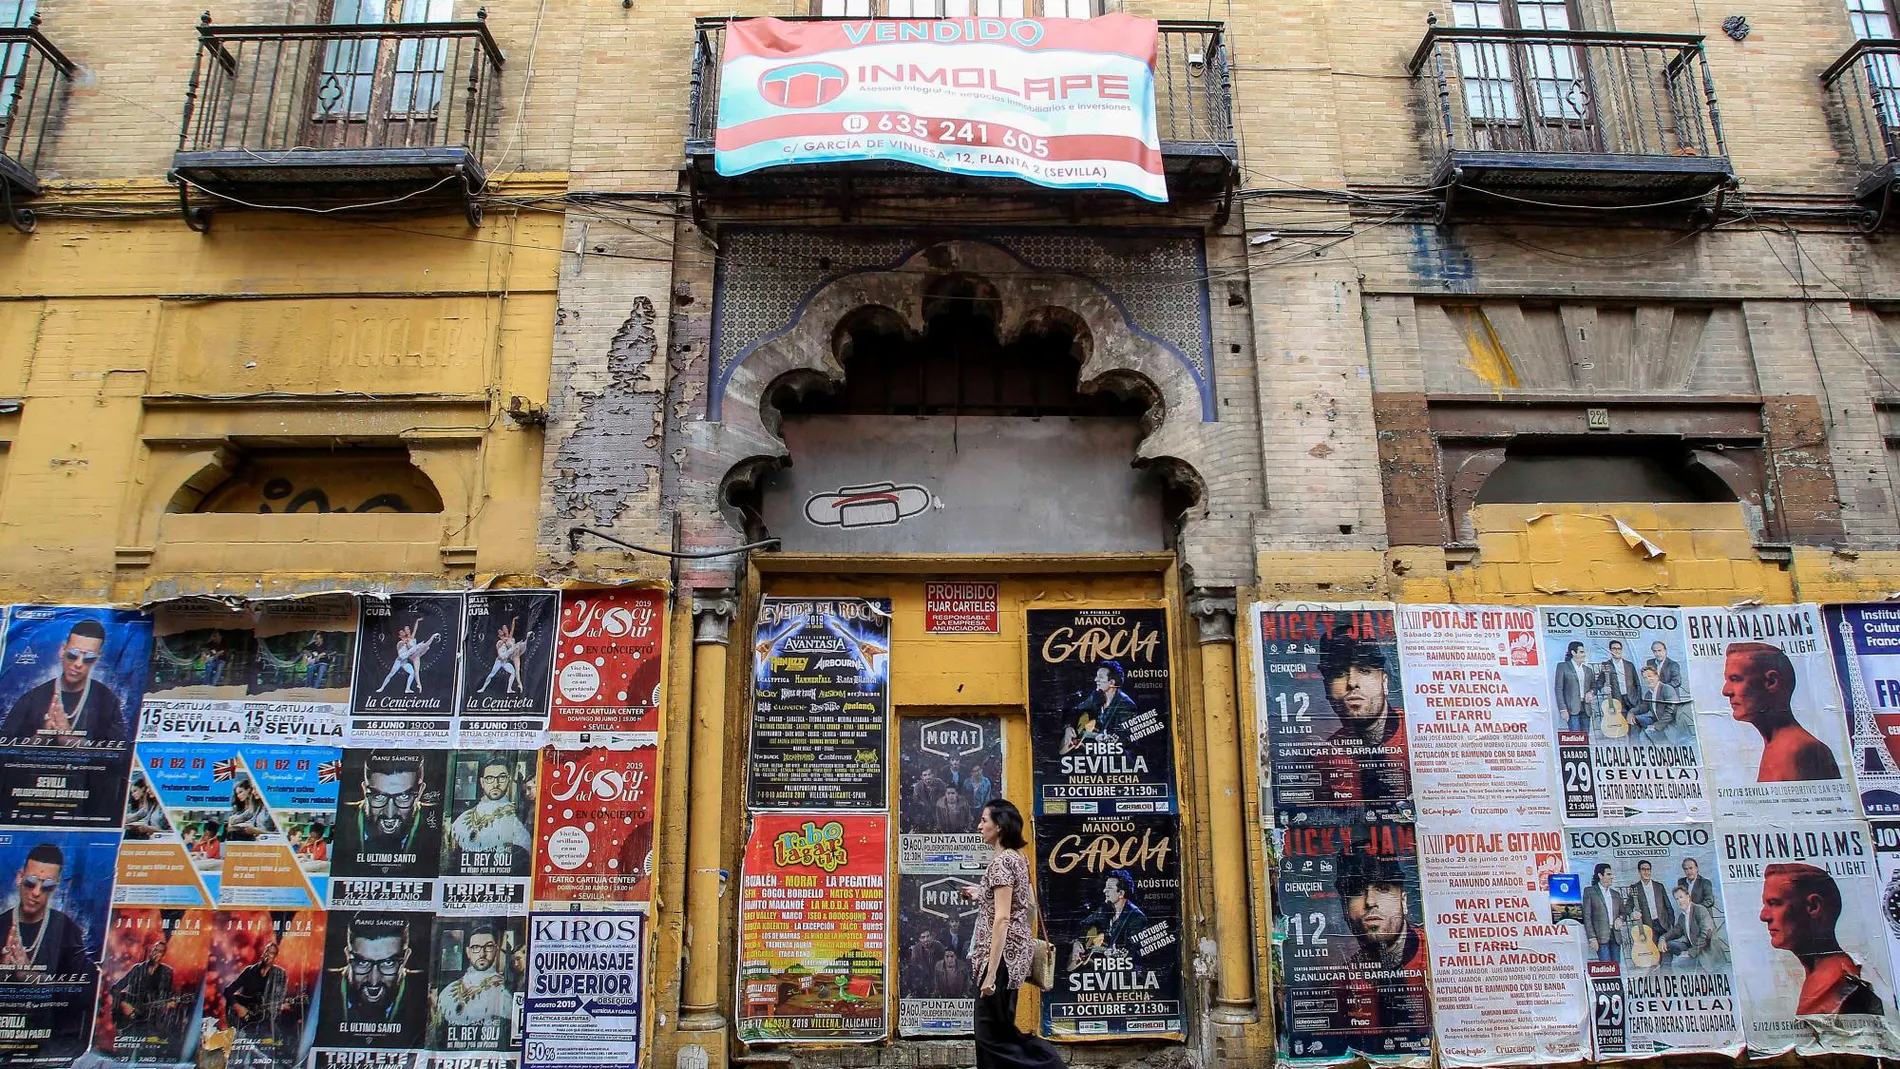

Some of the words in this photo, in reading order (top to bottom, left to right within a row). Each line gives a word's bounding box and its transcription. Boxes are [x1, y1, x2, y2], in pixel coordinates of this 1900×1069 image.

[842, 20, 1044, 46] VENDIDO
[859, 66, 1130, 100] INMOLAPE
[959, 91, 1005, 103] negocios
[1007, 99, 1065, 113] inmobiliarios
[878, 114, 927, 139] 635
[939, 120, 988, 143] 241
[1003, 129, 1049, 157] 605
[803, 137, 862, 152] GARCÍA
[867, 139, 884, 148] DE
[888, 140, 949, 162] VINUESA,
[955, 152, 975, 166] 12,
[980, 154, 1029, 170] PLANTA
[1033, 163, 1041, 175] 2
[1044, 165, 1107, 179] (SEVILLA)
[928, 585, 995, 600] PROHIBIDO
[366, 608, 391, 616] CUBA
[928, 602, 950, 612] FIJAR
[953, 601, 995, 612] CARTELES
[807, 616, 824, 625] 2019
[1075, 616, 1125, 626] MANOLO
[1262, 612, 1340, 640] NICKY
[1351, 610, 1396, 640] JAM
[1422, 612, 1478, 629] POTAJE
[1482, 612, 1534, 629] GITANO
[1546, 613, 1592, 628] ECOS
[1595, 616, 1617, 625] DEL
[1617, 613, 1677, 630] ROCIO
[784, 638, 846, 650] AVANTASIA
[1042, 622, 1160, 663] GARCÍA
[1693, 643, 1723, 656] SHINE
[1780, 640, 1786, 654] A
[1789, 639, 1816, 653] LIGHT
[586, 646, 598, 654] EN
[601, 645, 653, 654] CONCIERTO
[1427, 652, 1465, 660] RAIMUNDO
[1467, 652, 1496, 660] AMADOR
[813, 656, 866, 670] AIRBOURNE
[1127, 669, 1168, 678] ACÚSTICO
[1432, 671, 1465, 680] MARI
[1470, 670, 1501, 680] PEÑA
[1415, 682, 1444, 694] JOSÉ
[1450, 684, 1508, 694] VALENCIA
[365, 697, 377, 708] la
[380, 696, 441, 708] Cenicienta
[1275, 692, 1312, 722] 12
[1426, 697, 1491, 707] REMEDIOS
[1496, 697, 1539, 706] AMAYA
[142, 709, 162, 725] 15
[1451, 710, 1492, 720] FARRU
[163, 721, 240, 733] SEVILLA
[1129, 721, 1165, 742] AGOTADAS
[1279, 726, 1312, 734] JULIO
[927, 730, 977, 745] MORAT
[65, 740, 125, 748] YANKEE
[1085, 742, 1123, 755] FIBES
[1279, 748, 1329, 757] SANLUCAR
[1346, 746, 1403, 756] BARRAMEDA
[1595, 747, 1631, 767] ALCALA
[1635, 747, 1646, 765] DE
[1649, 746, 1697, 767] GUADAIRA
[151, 758, 163, 768] B1
[170, 758, 184, 768] B2
[192, 758, 205, 769] C1
[1061, 756, 1148, 774] SEVILLA
[1069, 775, 1104, 784] NUEVA
[1107, 775, 1139, 784] FECHA
[1564, 761, 1592, 792] 29
[1597, 769, 1699, 780] (SEVILLA)
[36, 777, 66, 788] SEVILLA
[1054, 787, 1066, 796] 12
[1069, 786, 1116, 796] OCTUBRE
[1124, 786, 1158, 796] 21:30H
[1598, 784, 1623, 799] TEATRO
[1626, 784, 1653, 799] RIBERAS
[1668, 783, 1702, 799] GUADAIRA
[1745, 786, 1770, 796] SEVILLA
[1471, 806, 1508, 814] Cruzcampo
[1082, 823, 1135, 833] MANOLO
[903, 838, 908, 850] 9
[1445, 834, 1504, 853] POTAJE
[1507, 831, 1561, 852] GITANO
[1571, 832, 1620, 848] ECOS
[1644, 829, 1709, 846] ROCIO
[1049, 828, 1171, 874] GARCÍA
[357, 854, 365, 862] EL
[393, 854, 416, 863] SANTO
[461, 853, 471, 866] EL
[474, 853, 490, 866] REY
[1729, 863, 1759, 879] SHINE
[1835, 861, 1867, 875] LIGHT
[344, 882, 423, 893] TRIPLETE
[786, 876, 818, 887] MORAT
[826, 876, 838, 887] LA
[839, 876, 883, 887] PEGATINA
[762, 889, 785, 898] GOGOL
[788, 889, 823, 898] BORDELLO
[856, 901, 883, 910] BOIKOT
[115, 919, 151, 928] JAVI
[162, 920, 200, 929] MOYA
[535, 921, 636, 941] KIROS
[535, 953, 634, 974] QUIROMASAJE
[1094, 957, 1133, 970] FIBES
[1439, 955, 1494, 967] FAMILIA
[1499, 953, 1556, 964] AMADOR
[536, 975, 631, 994] SUPERIOR
[1069, 971, 1160, 991] SEVILLA
[922, 1001, 955, 1009] PUNTA
[792, 1019, 808, 1028] 2019
[811, 1019, 839, 1028] VILLENA
[527, 1042, 555, 1060] 50%
